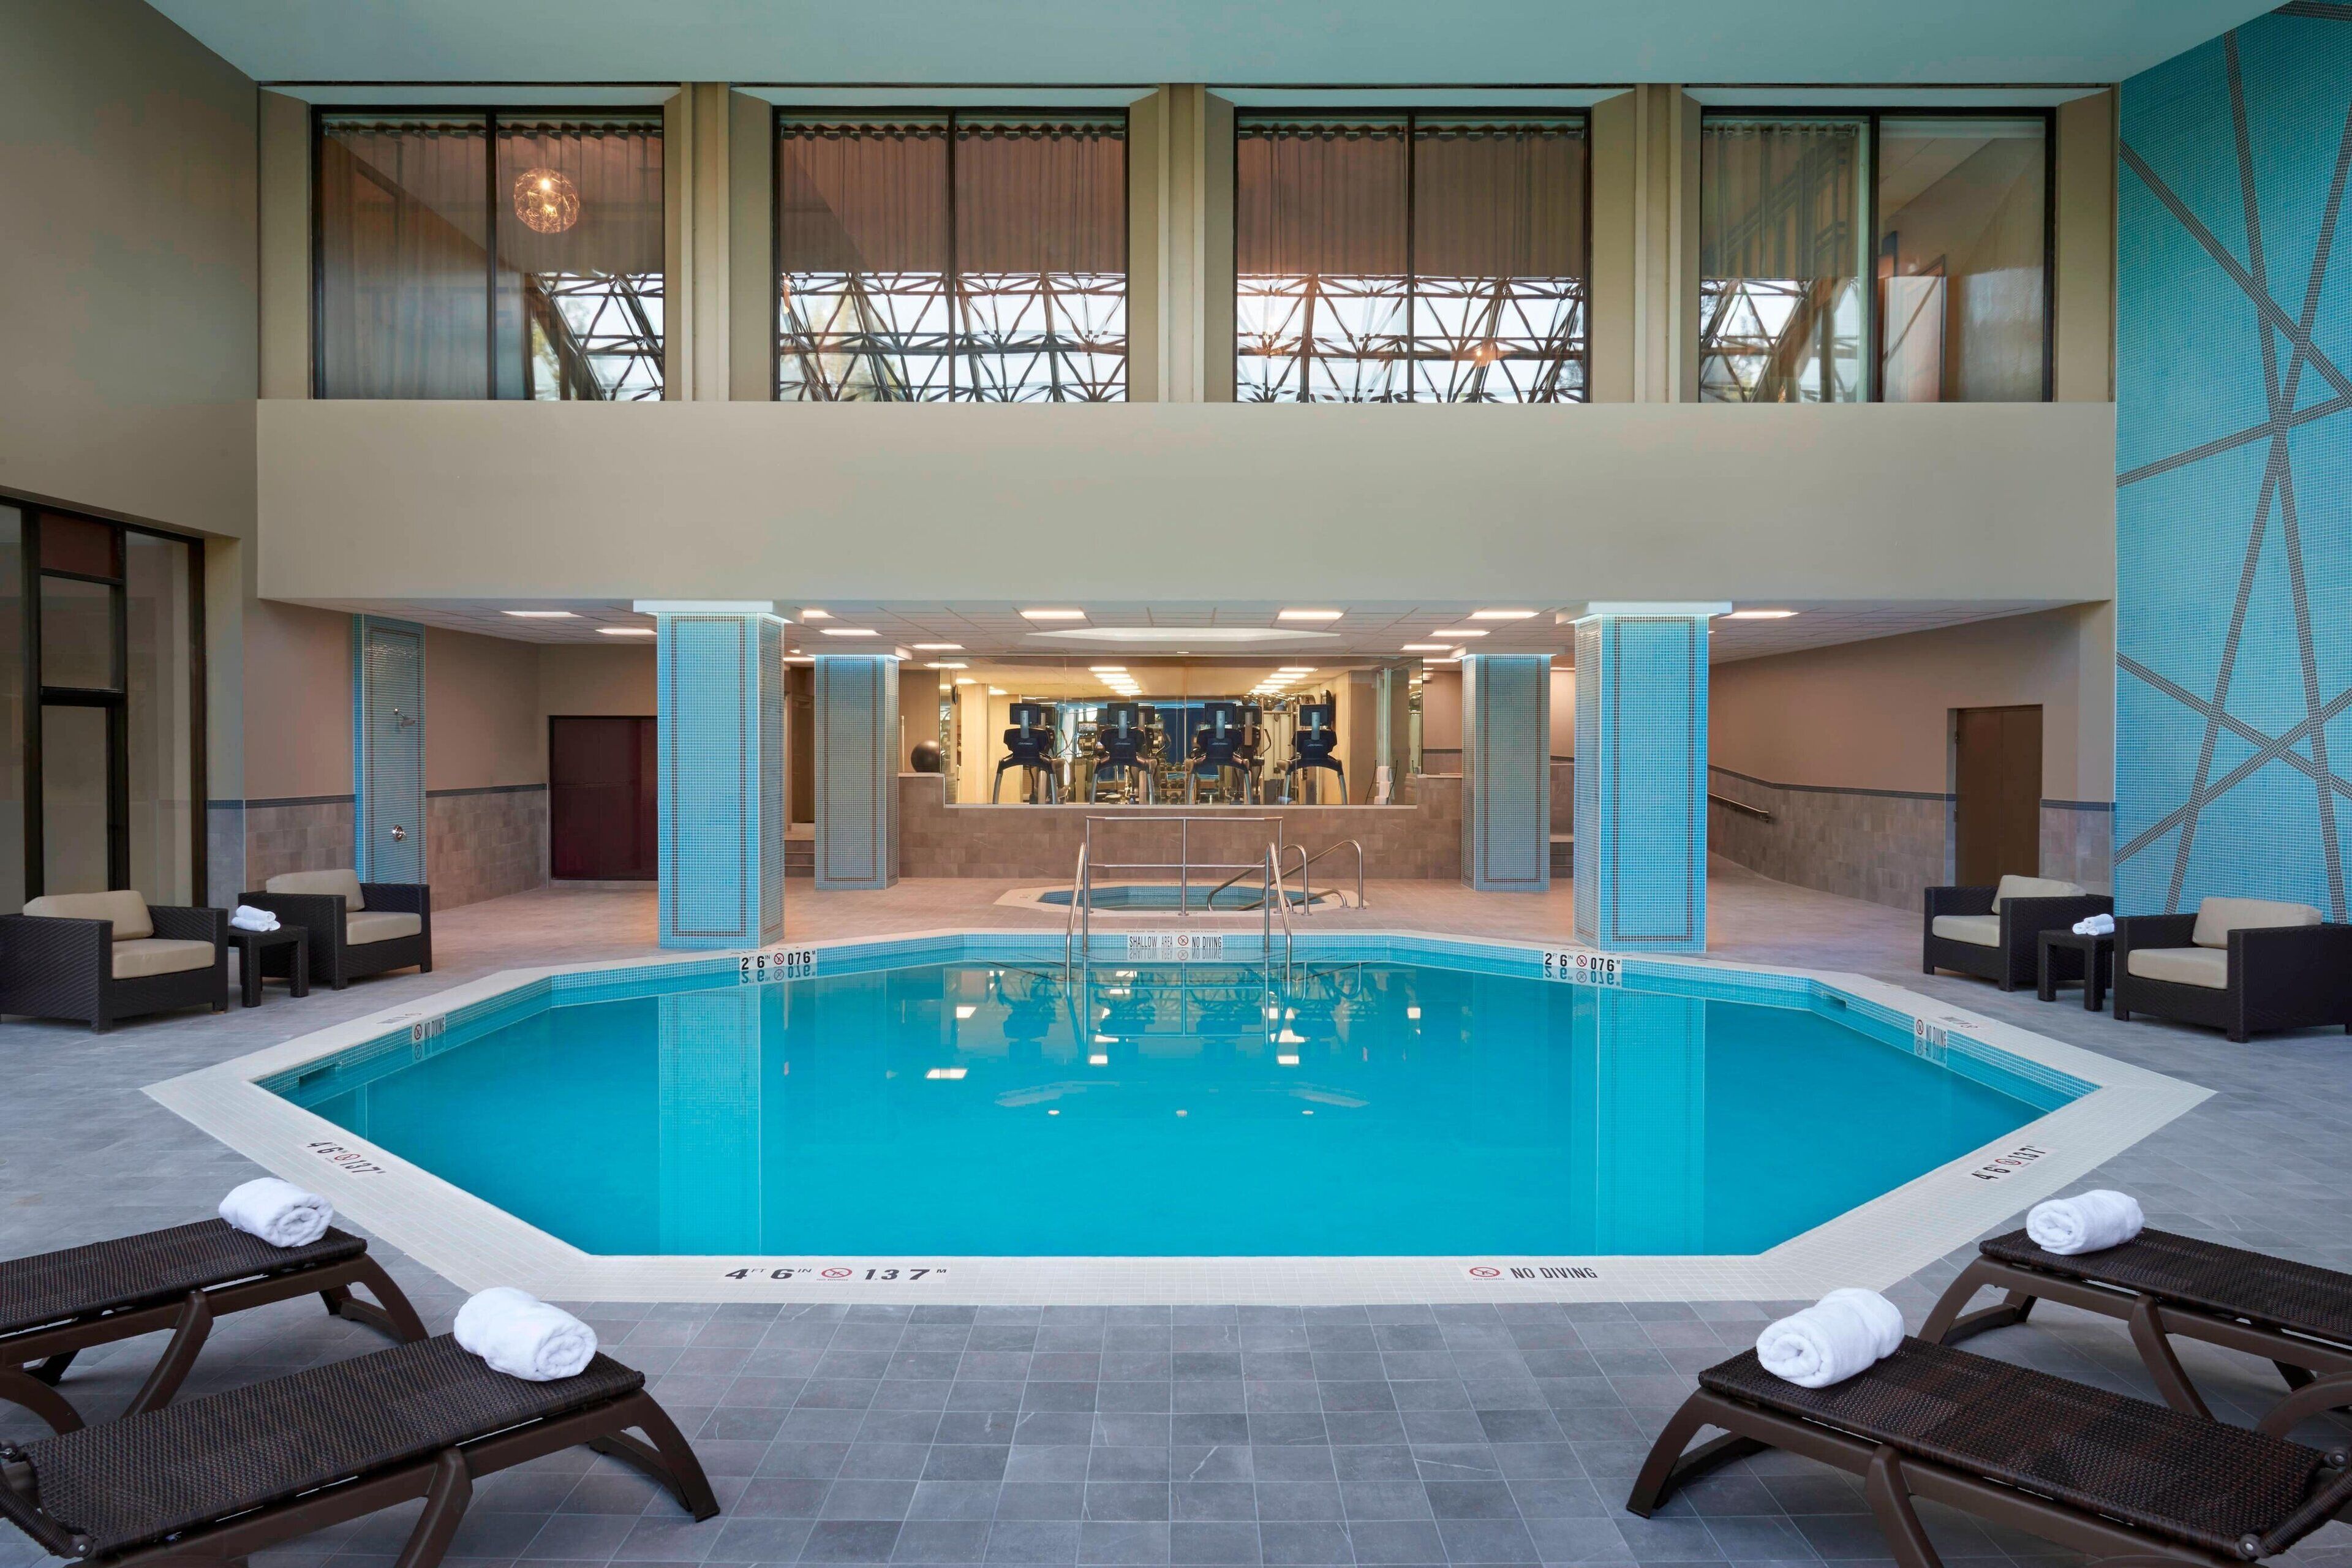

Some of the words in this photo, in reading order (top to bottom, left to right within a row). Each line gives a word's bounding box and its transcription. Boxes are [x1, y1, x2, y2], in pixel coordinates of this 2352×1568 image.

[1129, 936, 1158, 948] SHALLOW
[1161, 936, 1173, 948] AREA
[1192, 937, 1200, 948] NO
[1202, 937, 1222, 948] DIVING
[1510, 1267, 1536, 1279] NO
[1539, 1267, 1598, 1279] DIVING
